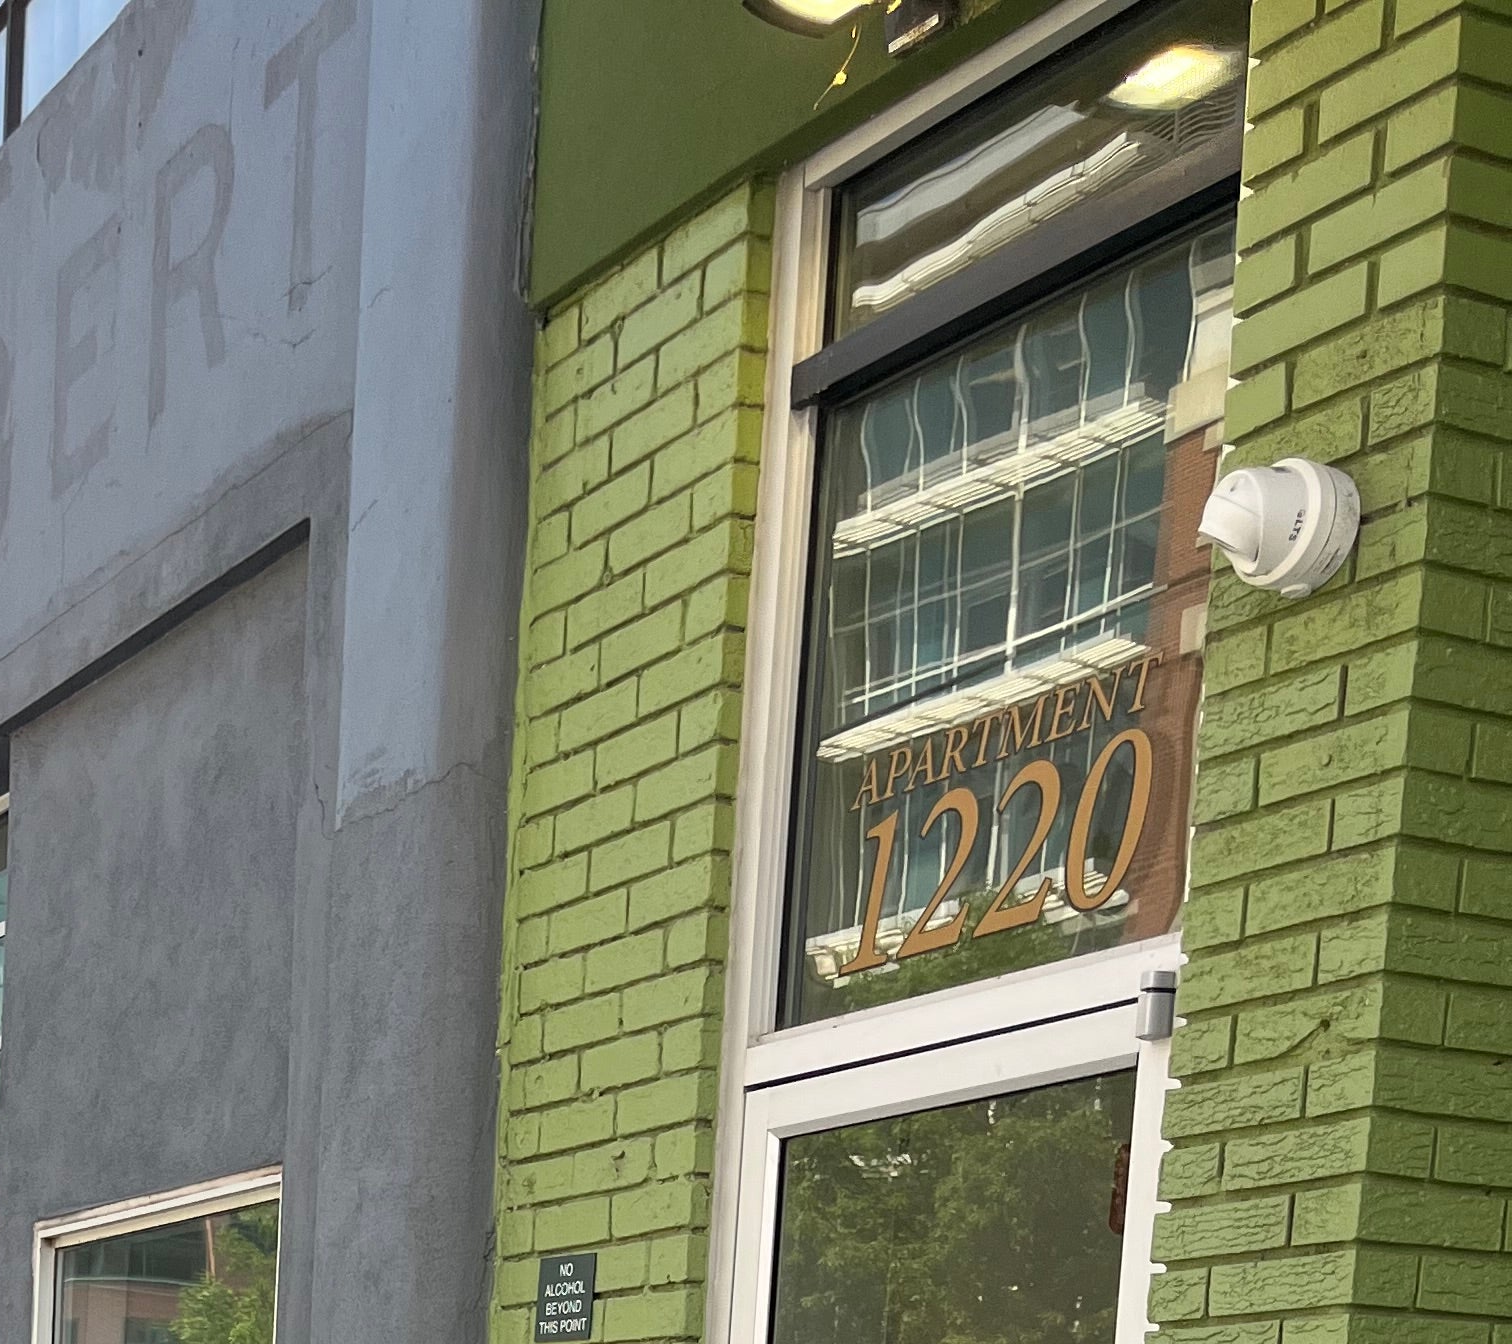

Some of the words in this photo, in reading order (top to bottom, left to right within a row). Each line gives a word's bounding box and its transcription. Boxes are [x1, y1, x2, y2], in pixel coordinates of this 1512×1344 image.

[850, 652, 1163, 812] APARTMENT
[839, 729, 1152, 976] 1220
[559, 1262, 574, 1277] NO
[544, 1280, 586, 1297] ALCOHOL
[545, 1299, 582, 1316] BEYOND
[539, 1321, 558, 1335] THIS
[559, 1317, 587, 1333] POINT
